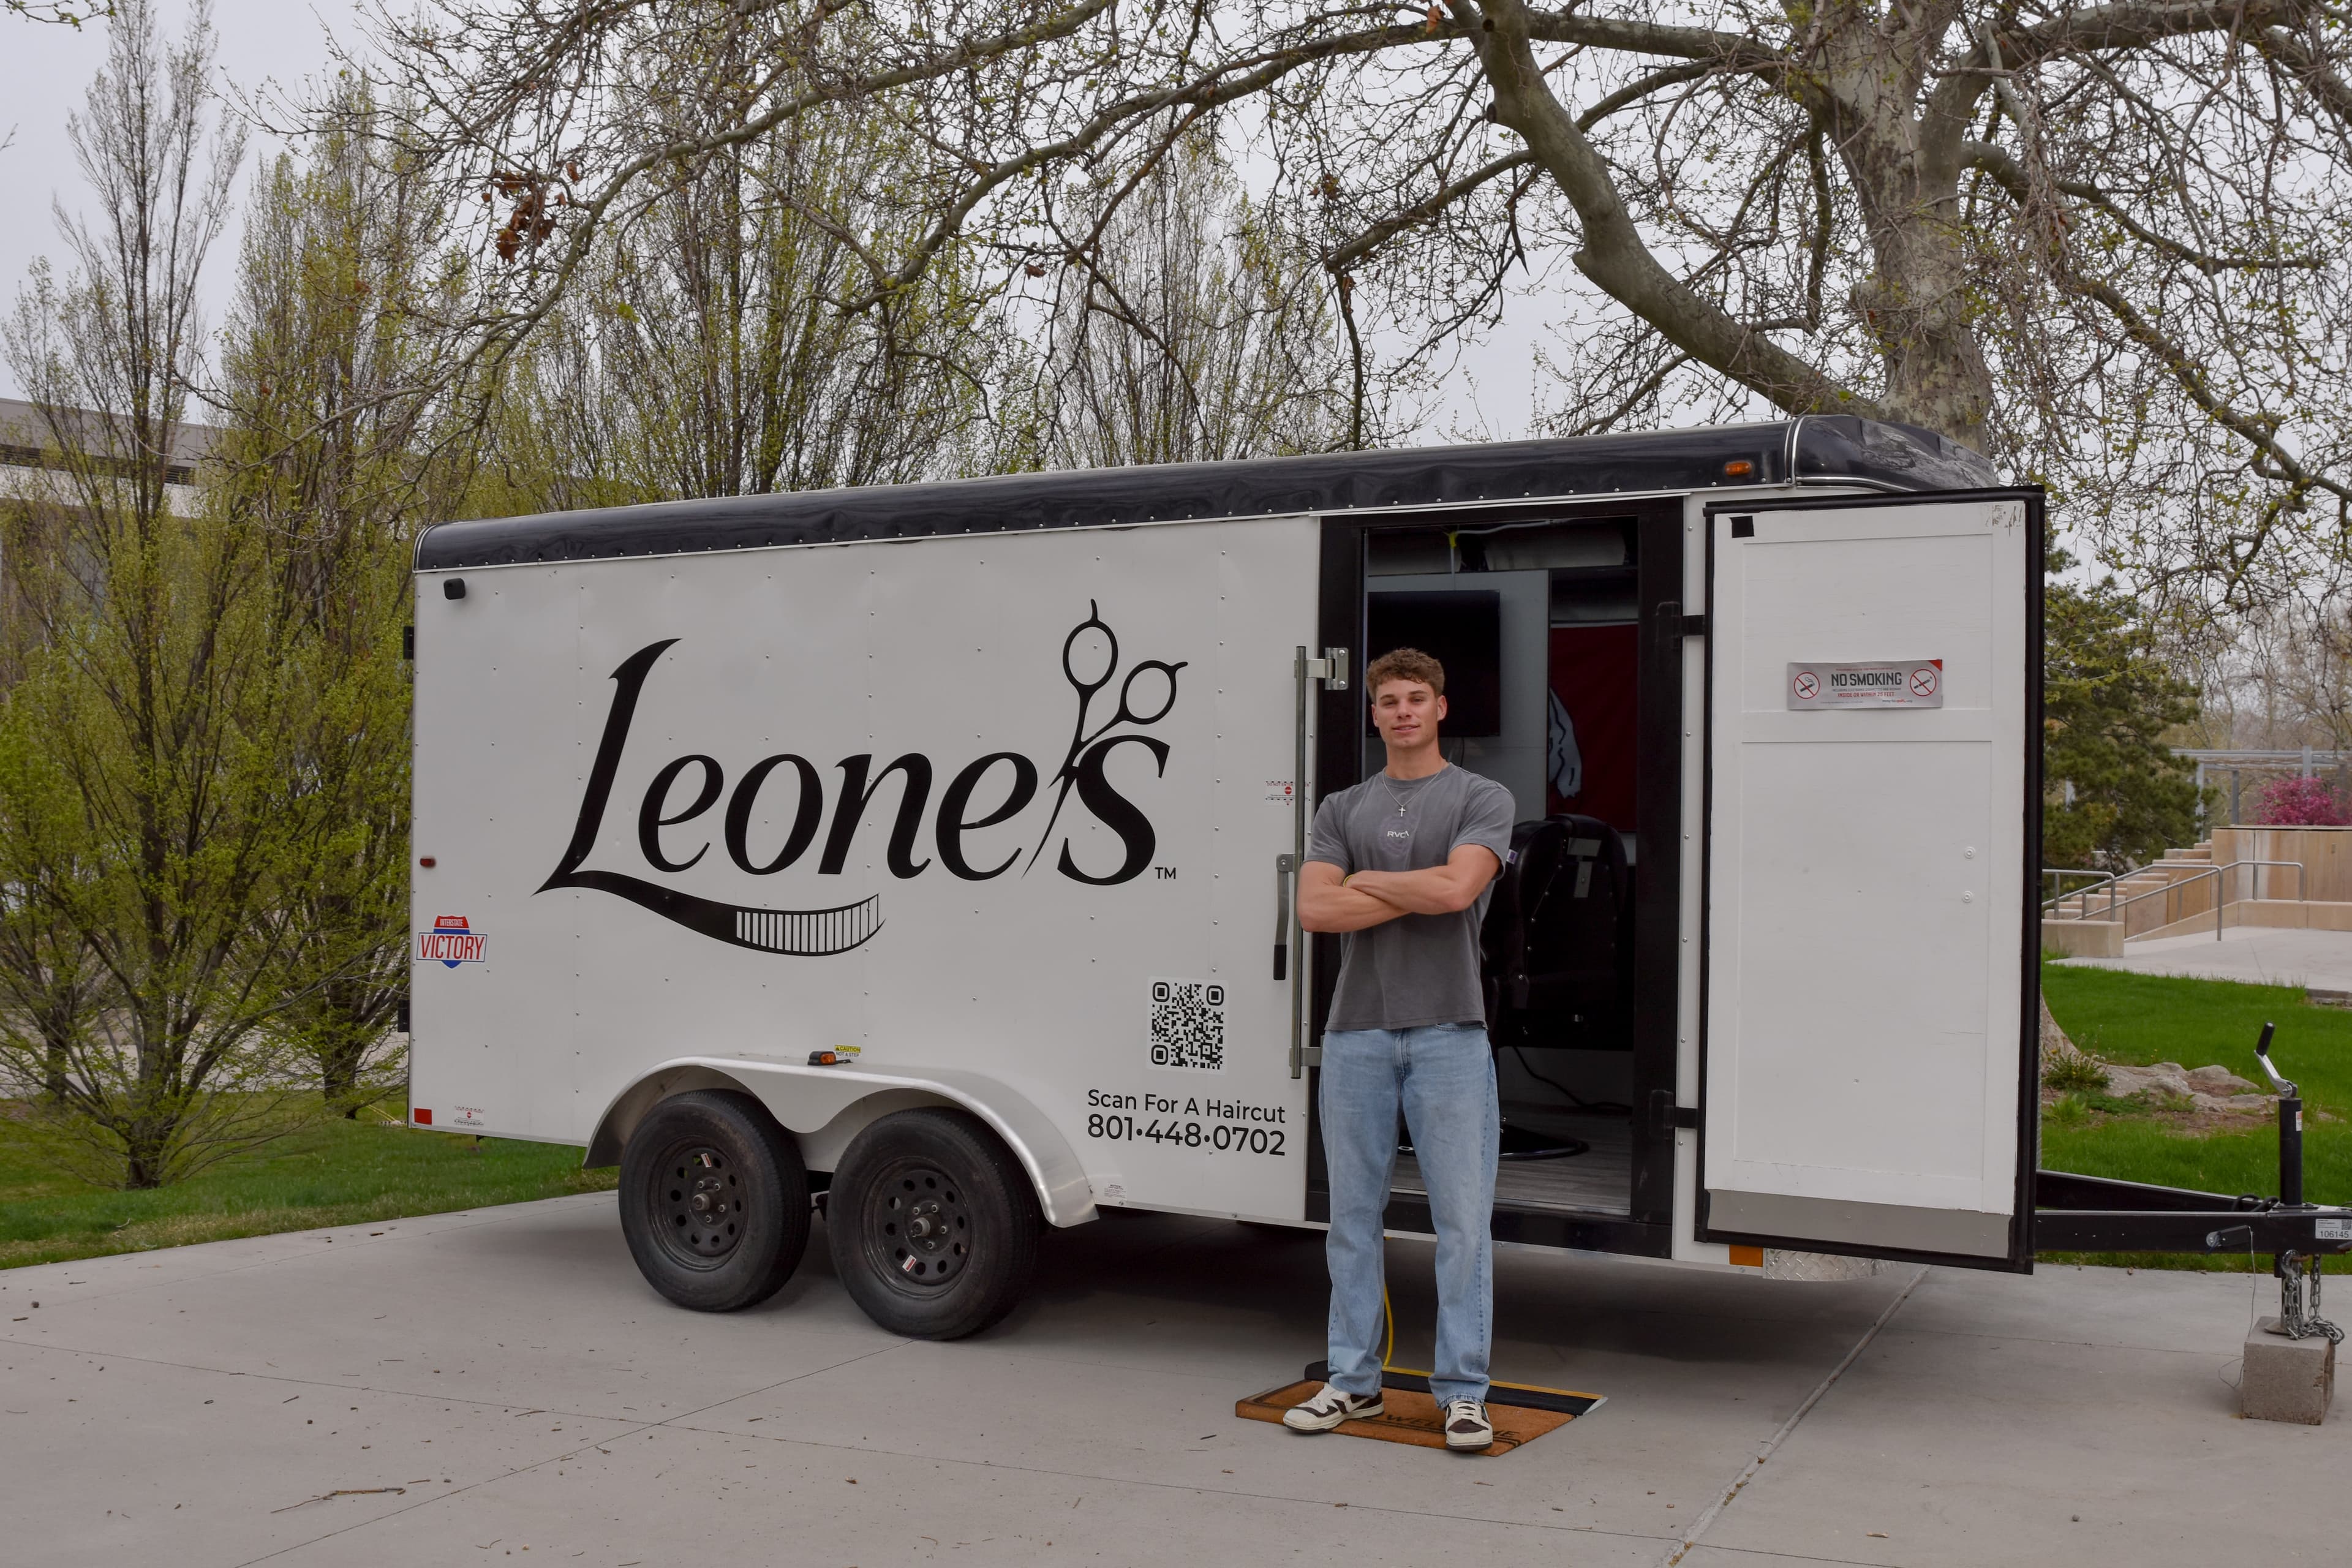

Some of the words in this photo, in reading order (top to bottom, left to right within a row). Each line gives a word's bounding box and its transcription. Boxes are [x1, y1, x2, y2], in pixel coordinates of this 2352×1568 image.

[1831, 674, 1847, 686] NO
[1850, 672, 1902, 686] SMOKING
[1155, 867, 1176, 879] TM
[421, 935, 485, 960] VICTORY
[1088, 1089, 1137, 1110] Scan
[1145, 1093, 1178, 1113] For
[1184, 1097, 1200, 1115] A
[1207, 1099, 1286, 1123] Haircut
